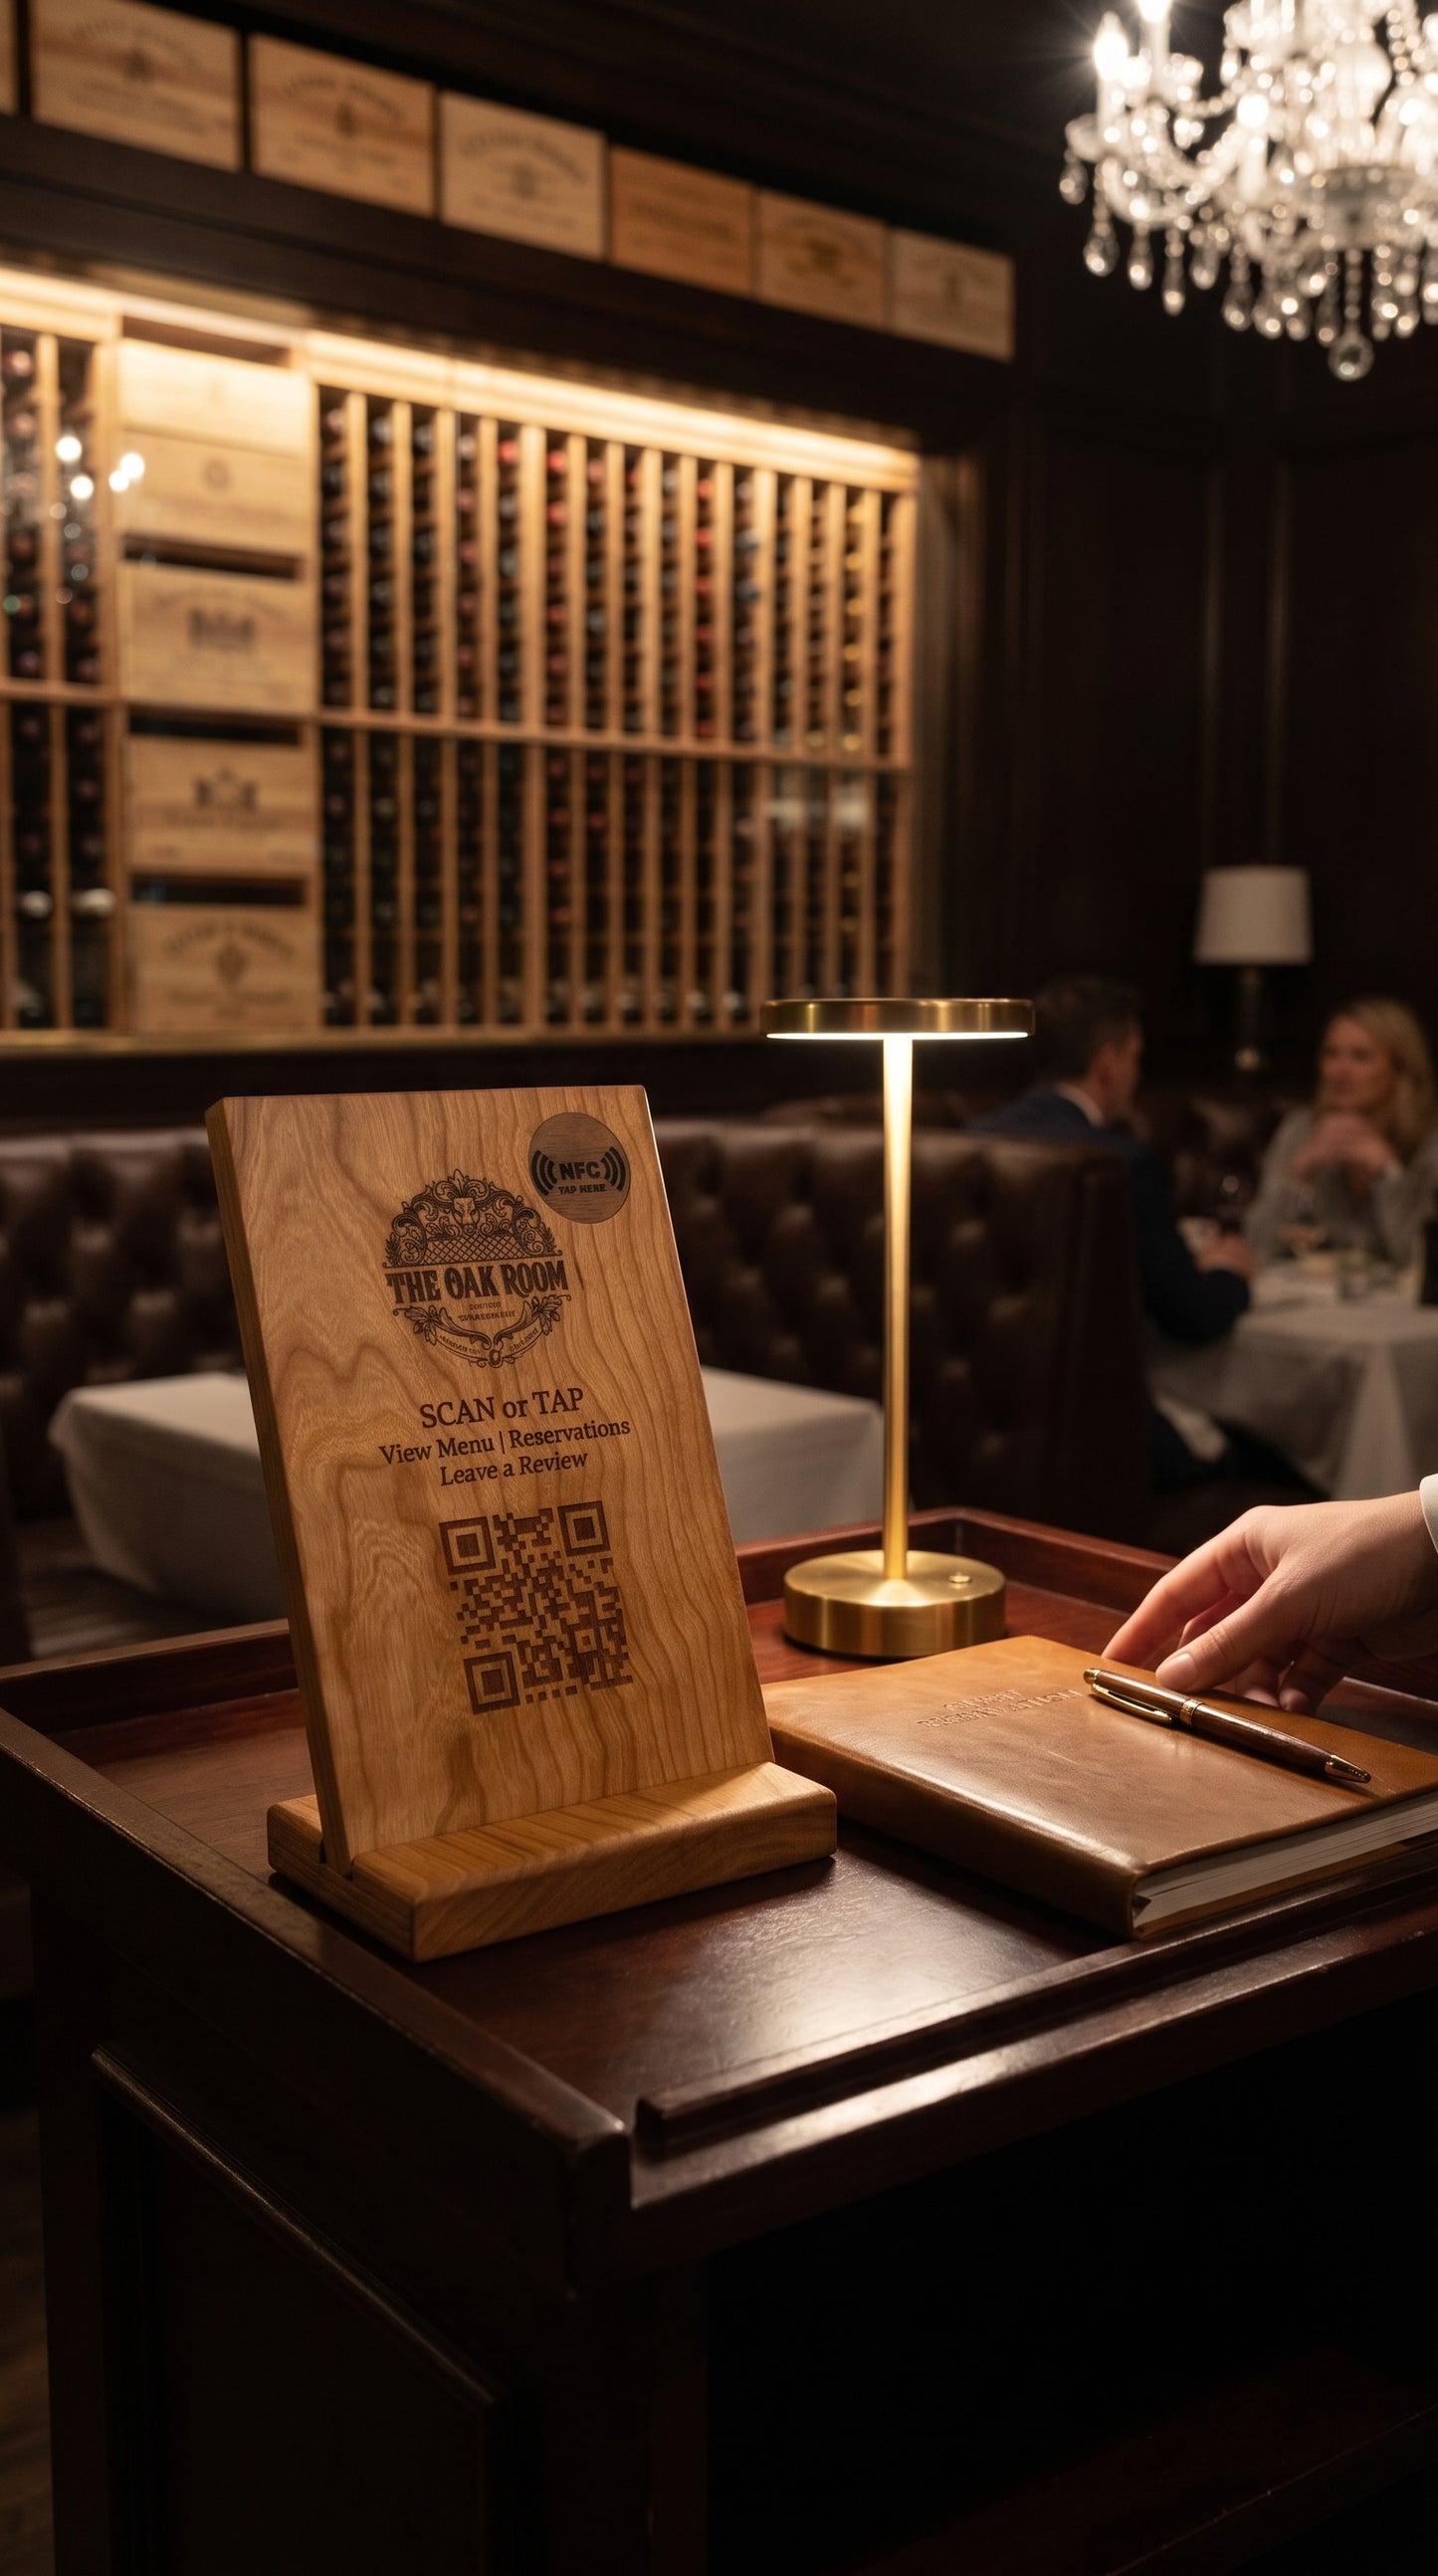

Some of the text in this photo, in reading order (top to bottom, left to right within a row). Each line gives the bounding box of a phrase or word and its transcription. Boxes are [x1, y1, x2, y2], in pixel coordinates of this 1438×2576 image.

[558, 1161, 601, 1181] NFC
[579, 1183, 607, 1194] HERE
[385, 1260, 569, 1304] THE OAK ROOM
[419, 1387, 584, 1429] SCAN or TAP
[378, 1444, 432, 1466] View
[436, 1436, 496, 1459] Menu
[508, 1419, 631, 1450] Reservations
[440, 1451, 589, 1486] Leave a Review
